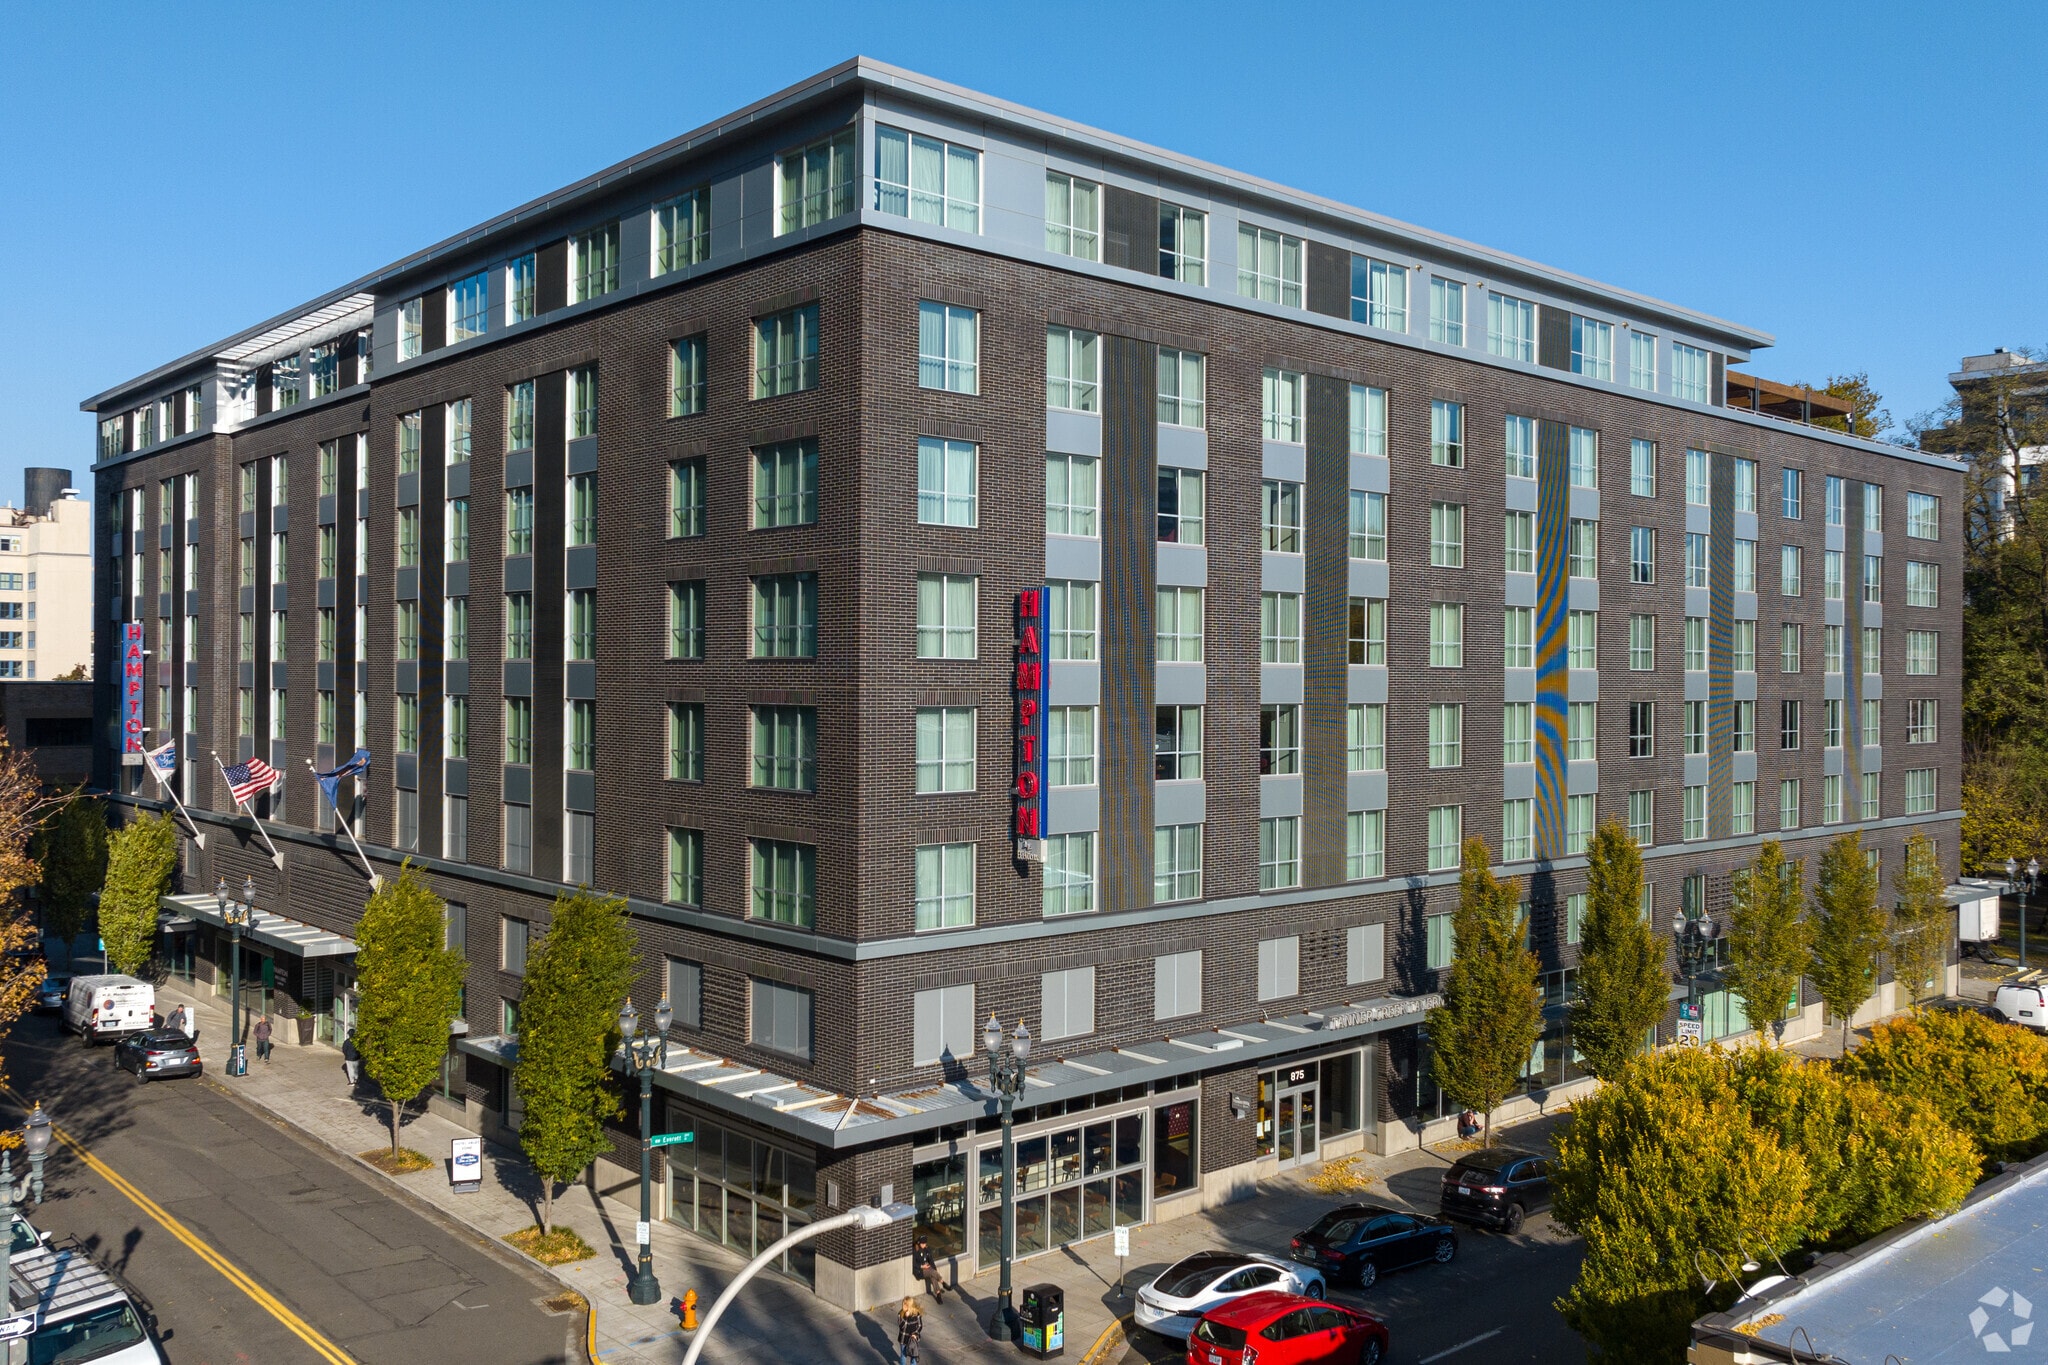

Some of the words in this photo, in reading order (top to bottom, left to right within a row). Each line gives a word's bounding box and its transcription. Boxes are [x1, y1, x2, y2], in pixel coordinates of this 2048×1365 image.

[126, 625, 142, 752] HAMPTON
[1017, 590, 1040, 836] HAMPTON
[1331, 1009, 1373, 1030] TANNER
[1376, 1002, 1407, 1021] CREEK
[1410, 996, 1445, 1014] TAVERN
[1679, 1035, 1699, 1046] 20
[1290, 1069, 1305, 1081] 875
